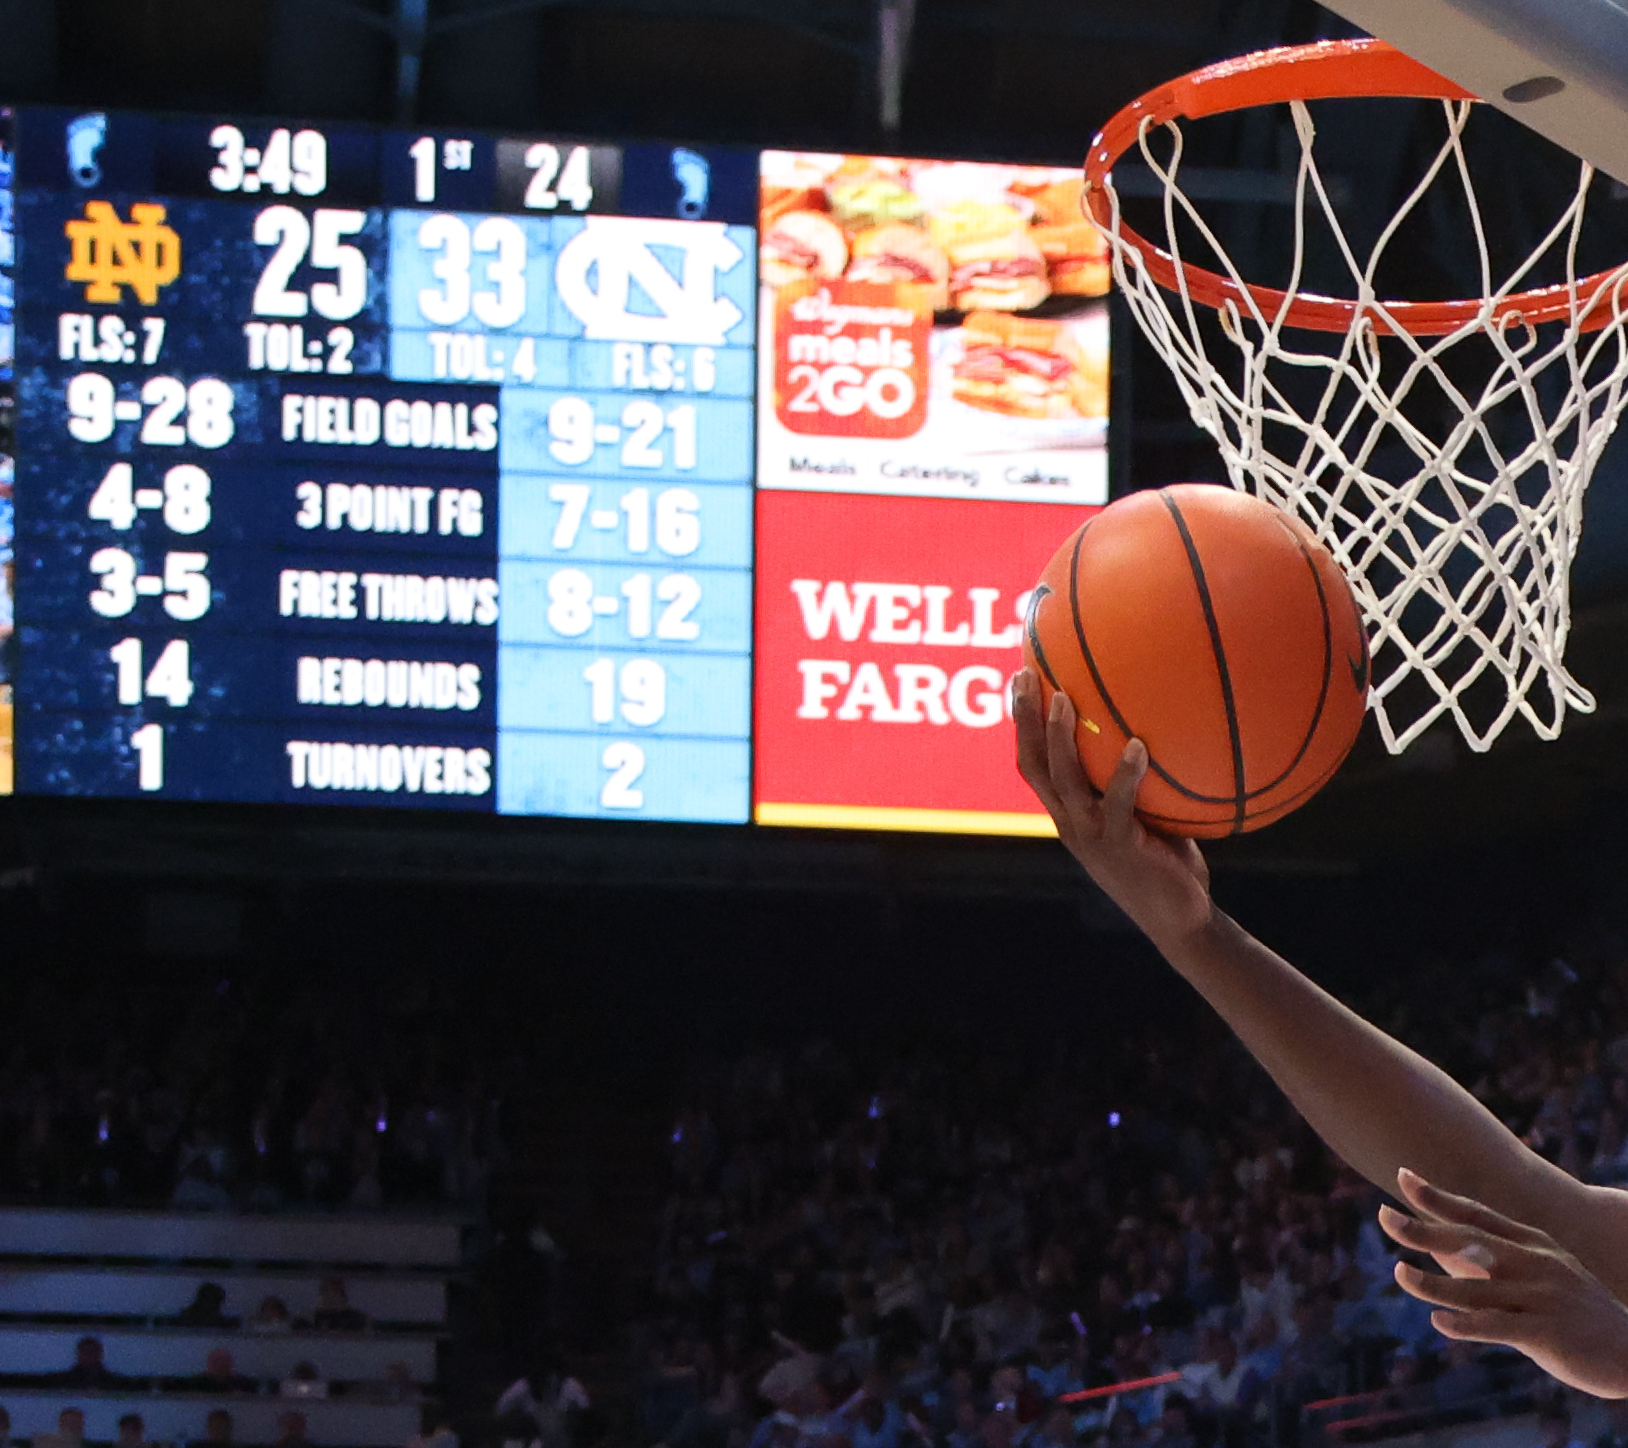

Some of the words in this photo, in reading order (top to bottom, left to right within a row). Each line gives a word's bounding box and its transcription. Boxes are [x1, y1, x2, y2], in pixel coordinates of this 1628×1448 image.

[209, 125, 327, 196] 3:49
[524, 142, 593, 210] 24
[252, 205, 368, 320] 25
[418, 213, 527, 329] 33
[58, 314, 139, 363] FLS:
[142, 318, 165, 364] 7
[245, 322, 323, 373] TOL:
[326, 327, 354, 374] 2
[429, 331, 508, 381] TOL:
[511, 337, 537, 382] 4
[612, 342, 686, 390] FLS:
[691, 347, 716, 392] 6
[787, 328, 913, 367] meals
[67, 372, 235, 449] 9-28
[282, 394, 379, 445] FIELD
[384, 398, 499, 450] GOALS
[786, 364, 918, 419] 2GO
[547, 395, 699, 471] 9-21
[789, 456, 857, 477] Meals
[88, 462, 213, 535] 4-8
[296, 481, 324, 529] 3
[326, 484, 432, 535] POINT
[439, 489, 484, 537] FG
[547, 483, 703, 557] 7-16
[88, 547, 213, 621] 3-5
[279, 569, 358, 620] FREE
[360, 572, 501, 626] THROWS
[545, 567, 703, 641] 8-12
[109, 638, 194, 707] 14
[297, 656, 483, 710] REBOUNDS
[582, 657, 668, 727] 19
[798, 660, 1014, 728] FARG
[129, 723, 164, 792] 1
[286, 739, 492, 796] TURNOVERS
[600, 742, 646, 810] 2
